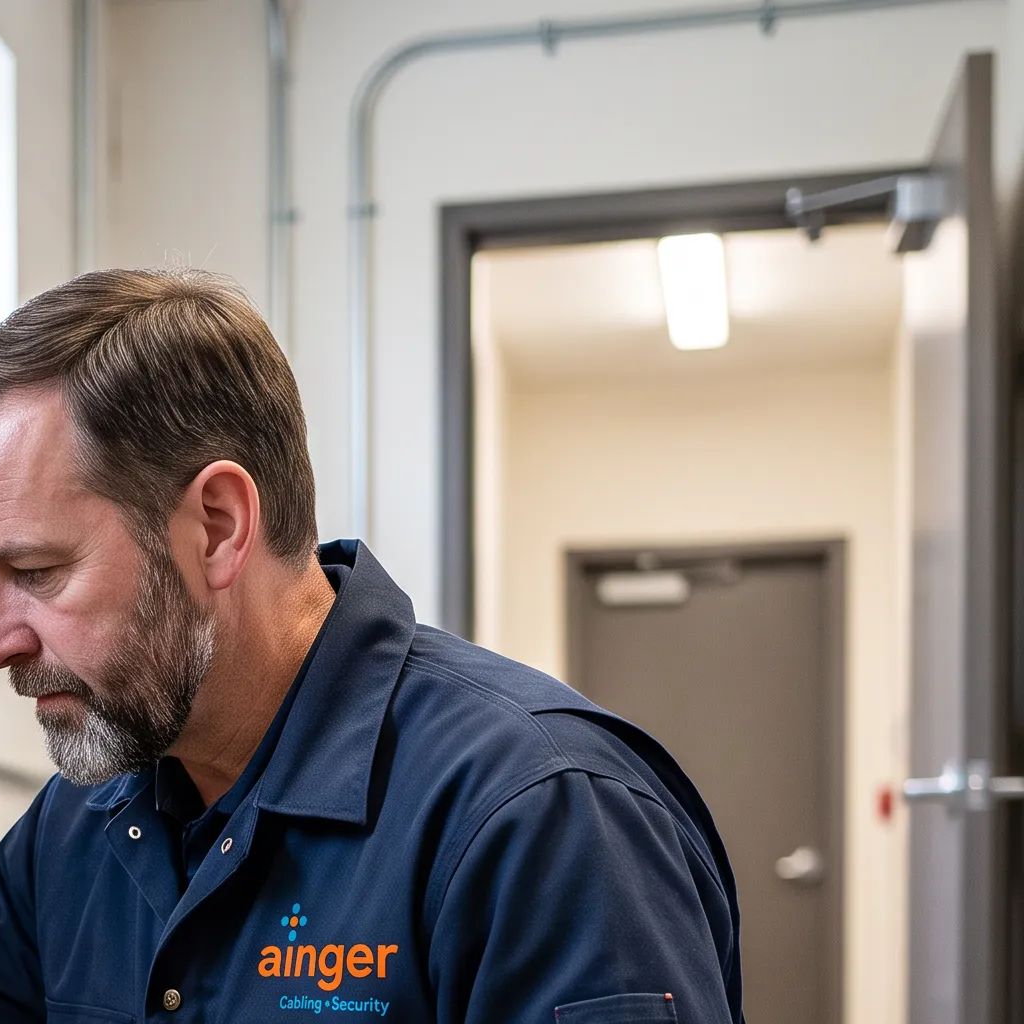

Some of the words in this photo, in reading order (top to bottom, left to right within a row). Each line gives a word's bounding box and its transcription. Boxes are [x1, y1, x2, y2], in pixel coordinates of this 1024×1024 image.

[257, 943, 399, 992] ainger
[279, 995, 322, 1014] Cabling
[331, 995, 390, 1016] Security
